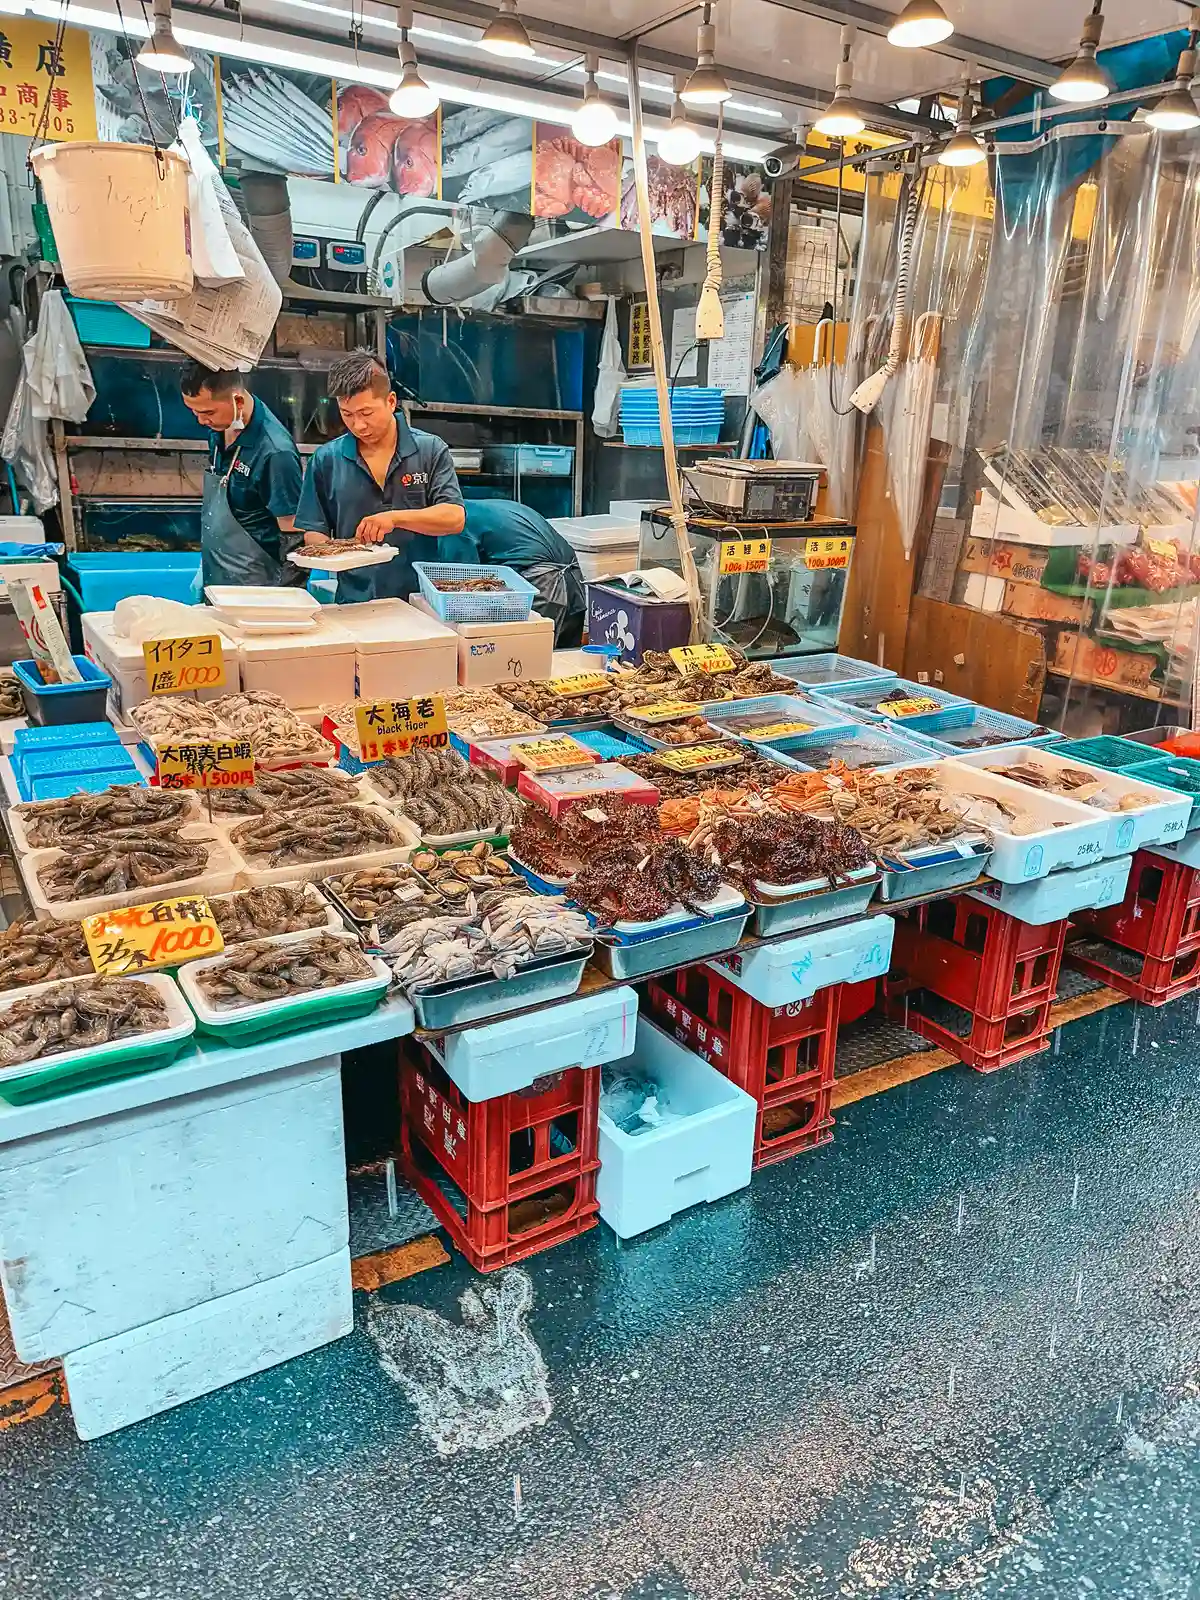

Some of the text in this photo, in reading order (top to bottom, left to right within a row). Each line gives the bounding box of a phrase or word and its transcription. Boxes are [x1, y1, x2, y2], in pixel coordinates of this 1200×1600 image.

[148, 639, 213, 664] イイタコ
[177, 666, 221, 687] 1000
[365, 698, 434, 725] 大海老
[377, 720, 429, 735] black tiger
[1163, 820, 1185, 833] 25枚入
[1077, 841, 1100, 856] 25枚入
